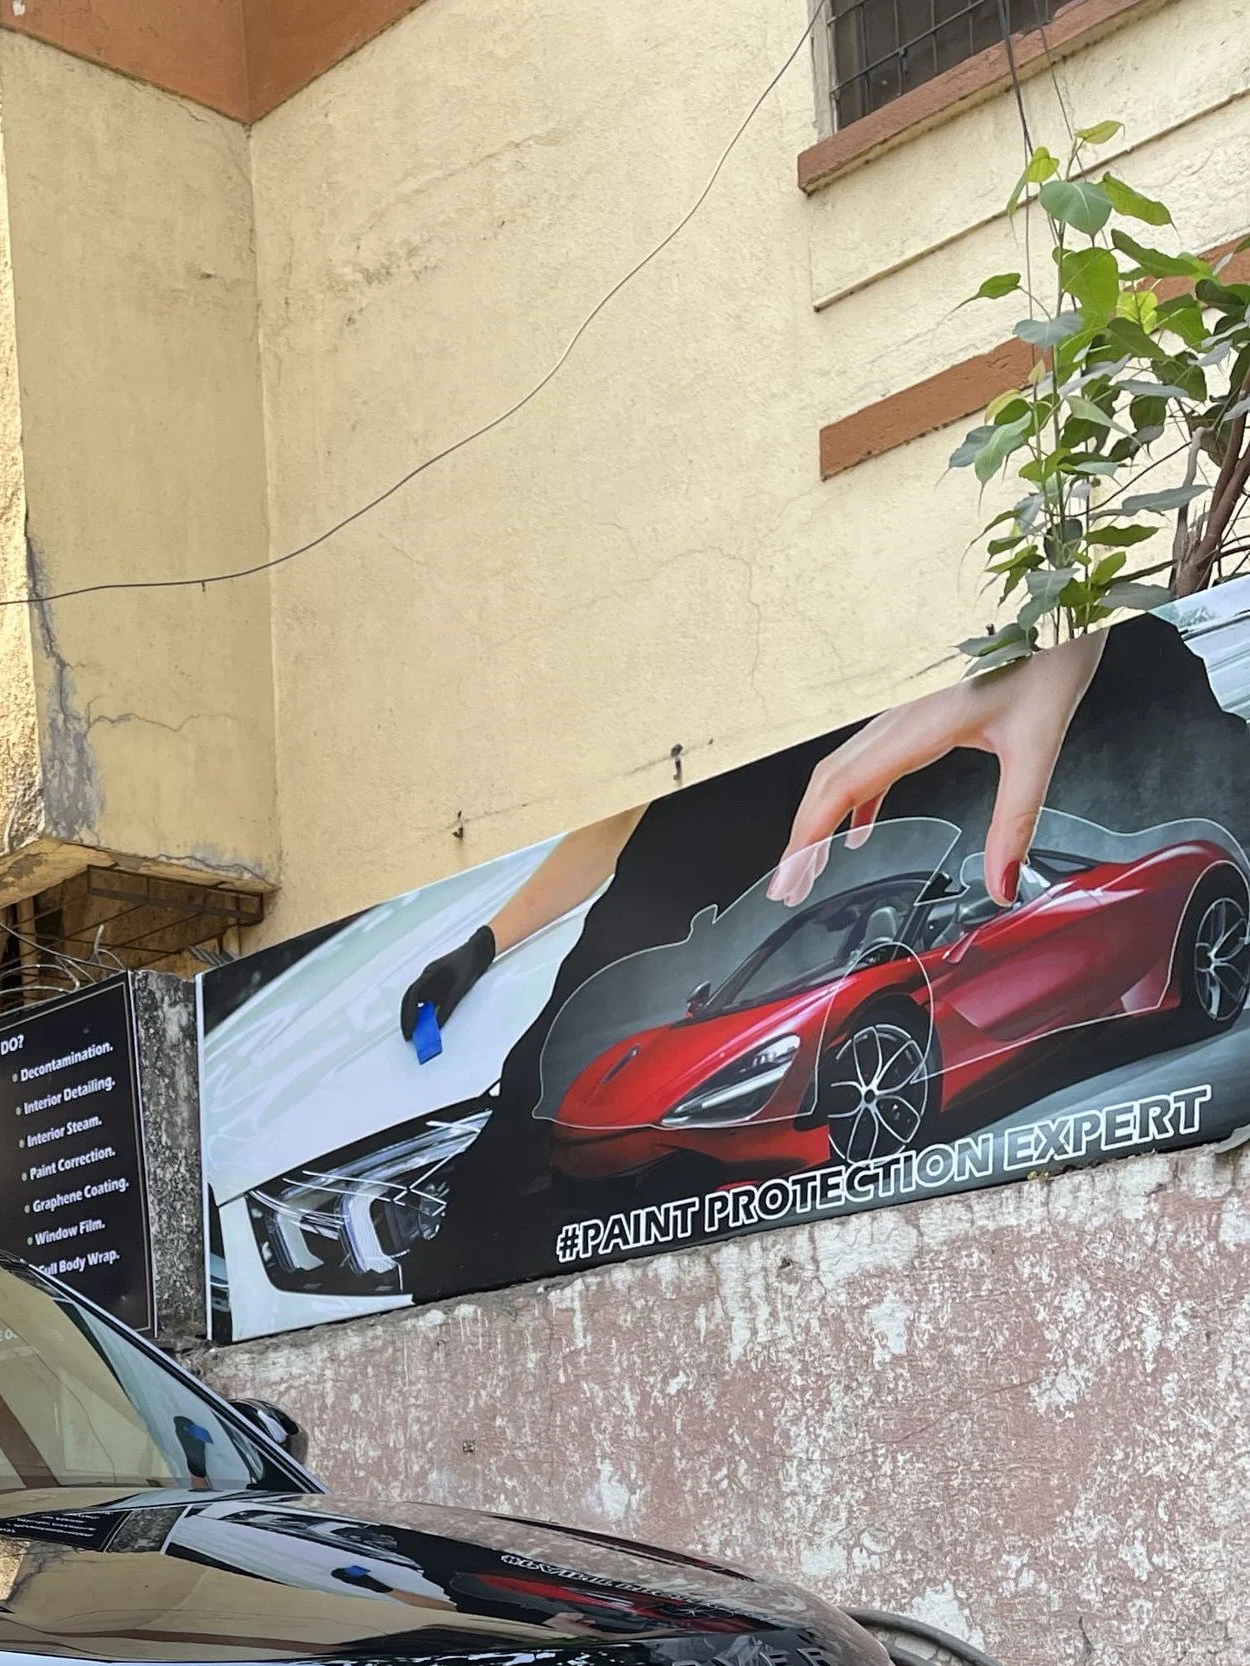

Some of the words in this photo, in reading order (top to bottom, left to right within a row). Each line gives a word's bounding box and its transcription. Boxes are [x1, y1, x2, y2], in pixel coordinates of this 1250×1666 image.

[0, 1034, 25, 1056] DO?
[20, 1042, 114, 1082] Decontamination.
[23, 1093, 63, 1115] Interior
[63, 1076, 116, 1102] Detailing.
[26, 1126, 66, 1148] Interior
[66, 1116, 103, 1136] Steam.
[29, 1162, 58, 1181] Paint
[57, 1146, 117, 1172] Correction.
[555, 1197, 700, 1264] #PAINT
[703, 1132, 995, 1233] PROTECTION
[1002, 1083, 1212, 1172] EXPERT
[32, 1190, 83, 1213] Graphene
[83, 1177, 130, 1199] Coating.
[34, 1225, 78, 1246] Window
[78, 1219, 106, 1235] Film.
[58, 1256, 86, 1273] Body
[86, 1249, 120, 1266] Wrap.
